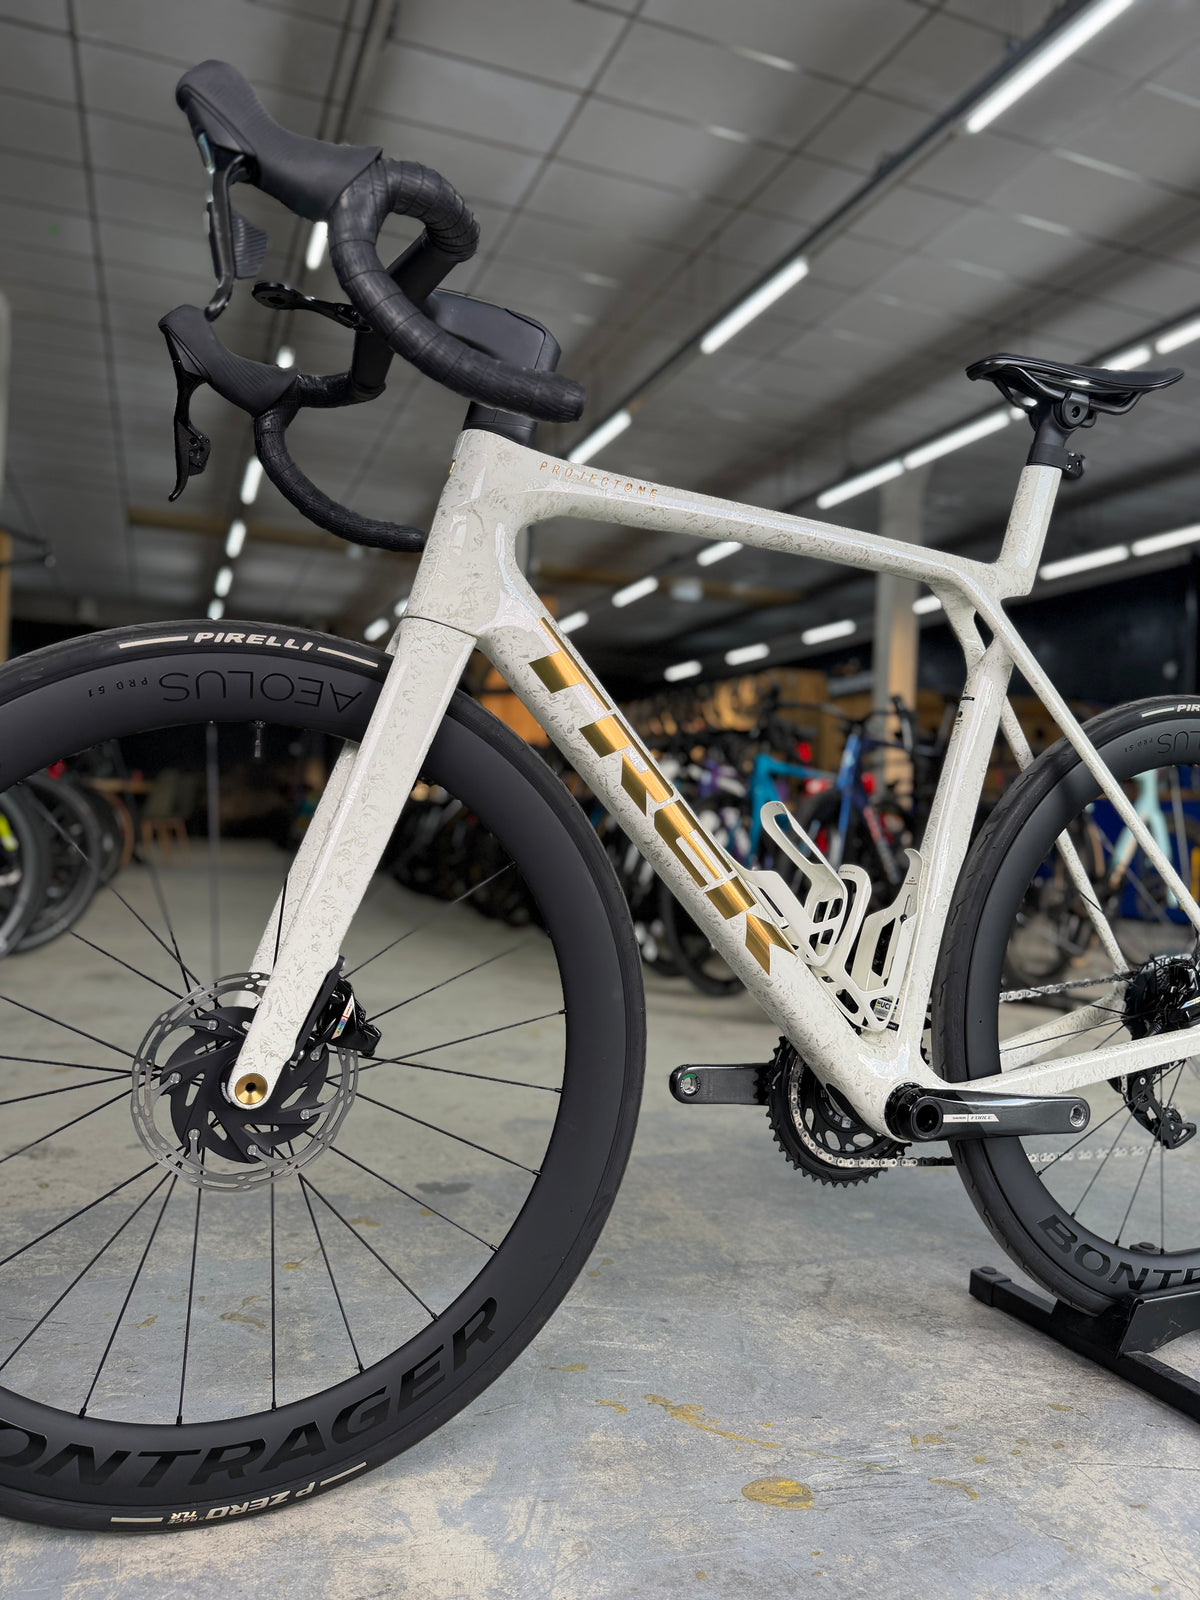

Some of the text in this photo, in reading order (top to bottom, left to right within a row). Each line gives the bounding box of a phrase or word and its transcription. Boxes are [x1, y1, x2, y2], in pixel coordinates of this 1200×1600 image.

[193, 632, 314, 652] PIRELLI
[116, 677, 148, 690] PRO
[158, 670, 363, 713] AEOLUS
[528, 617, 799, 976] TREK
[295, 1481, 316, 1498] P
[170, 1510, 197, 1520] TLR
